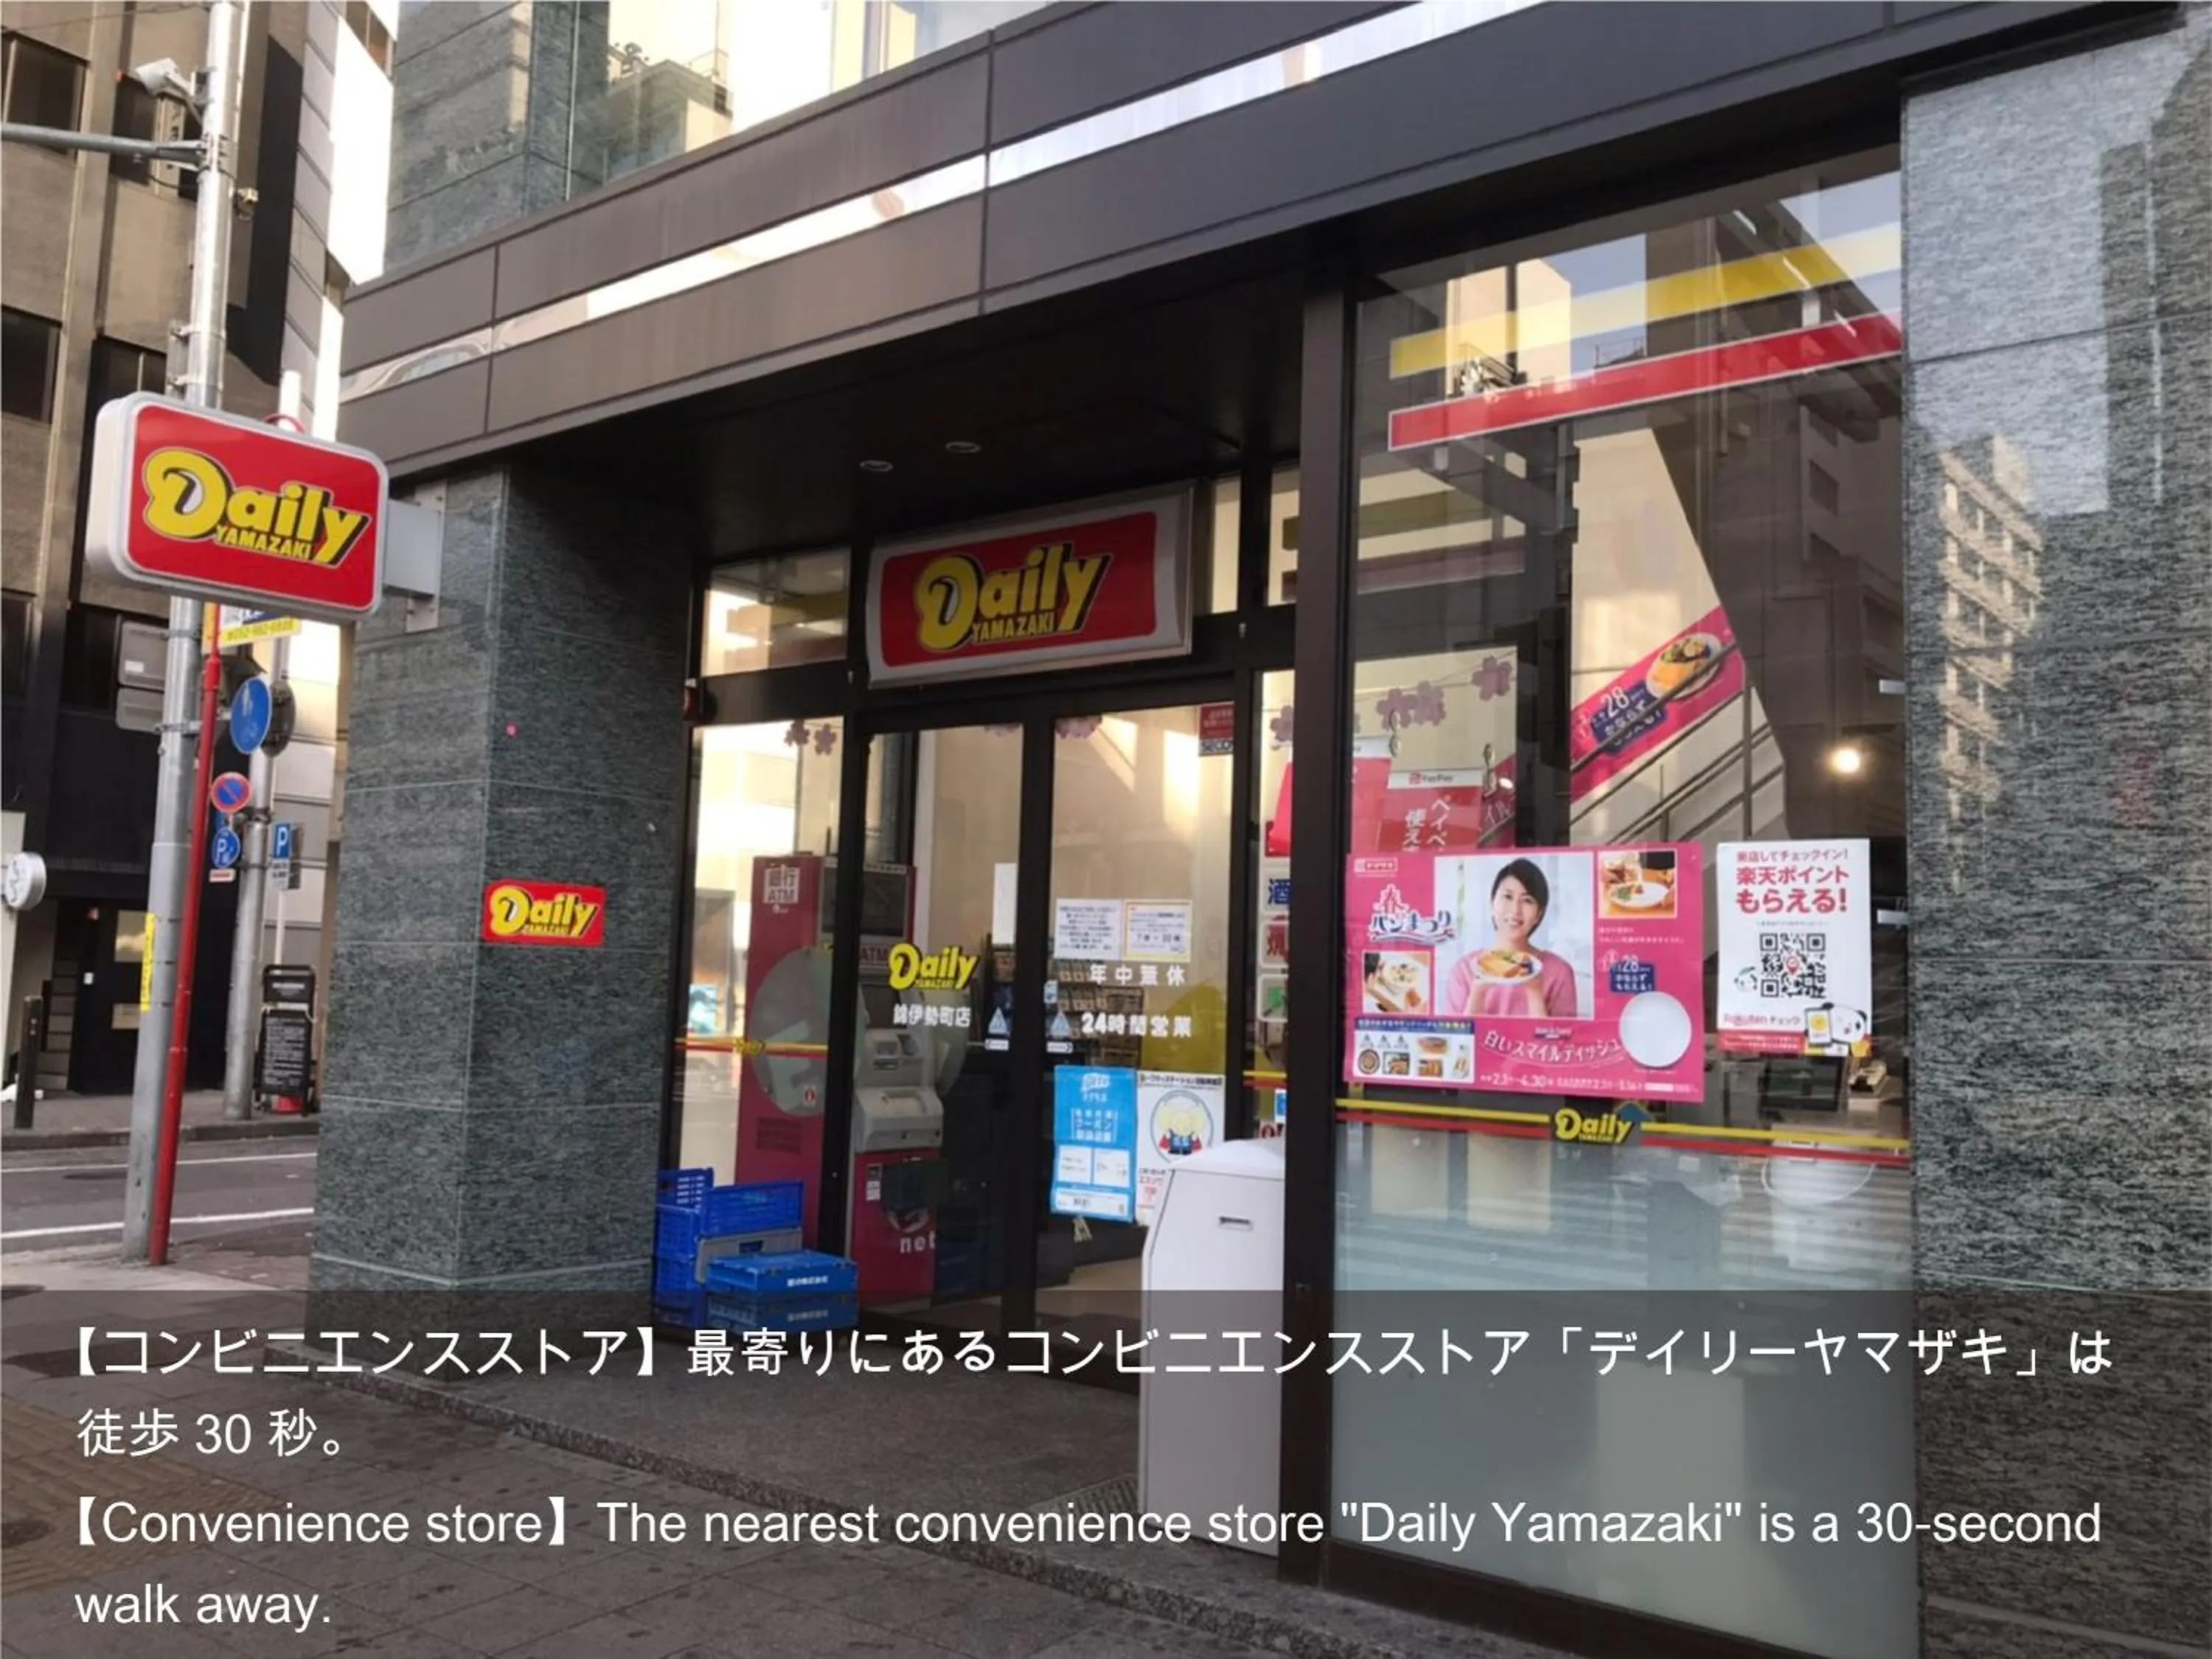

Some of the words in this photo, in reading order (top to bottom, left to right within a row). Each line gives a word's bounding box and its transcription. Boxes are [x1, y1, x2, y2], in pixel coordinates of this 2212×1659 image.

[144, 448, 372, 568] Daily
[215, 524, 313, 560] YAMAZAKI
[915, 543, 1113, 652] Daily
[973, 612, 1054, 641] YAMAZAKI
[1736, 865, 1849, 885] 楽天ポイント
[490, 885, 599, 938] Daily
[888, 943, 979, 990] Daily
[1091, 964, 1185, 986] 年中無休
[1082, 1012, 1192, 1038] 24時間営業
[1555, 1107, 1632, 1144] Daily
